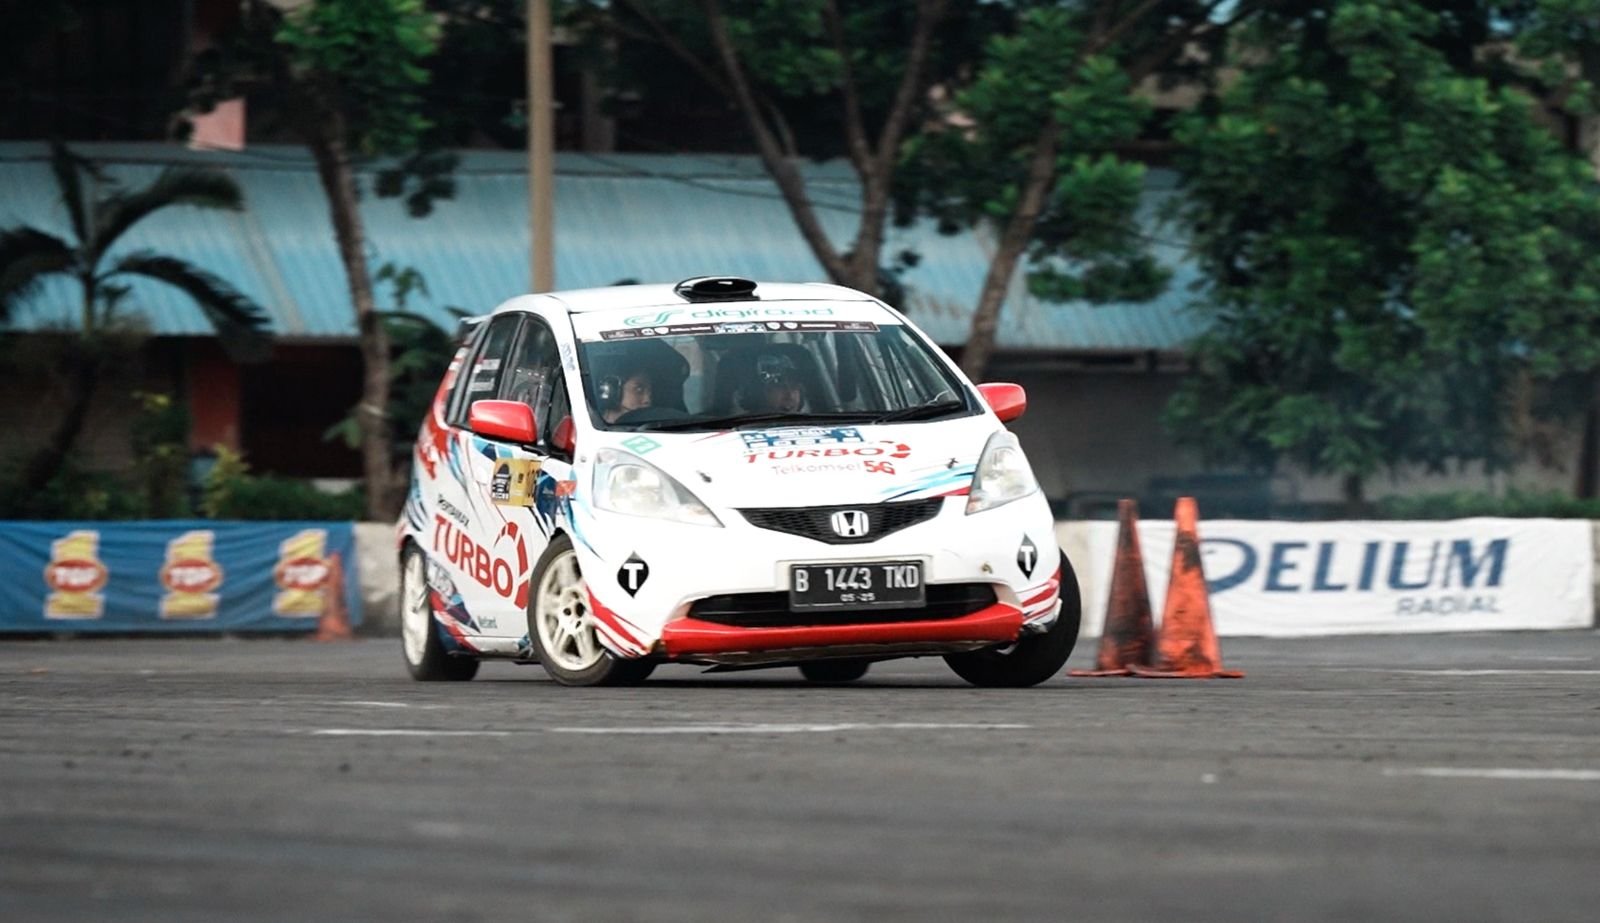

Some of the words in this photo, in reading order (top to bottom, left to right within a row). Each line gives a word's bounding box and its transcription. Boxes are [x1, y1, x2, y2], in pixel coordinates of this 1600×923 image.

[743, 448, 885, 464] TURBO
[771, 463, 861, 476] Telkomsel
[863, 461, 896, 476] 5G
[432, 513, 514, 599] TURBO
[795, 568, 810, 592] B
[824, 566, 872, 591] 1443
[881, 565, 920, 589] TKD
[1395, 596, 1504, 617] RADIAL
